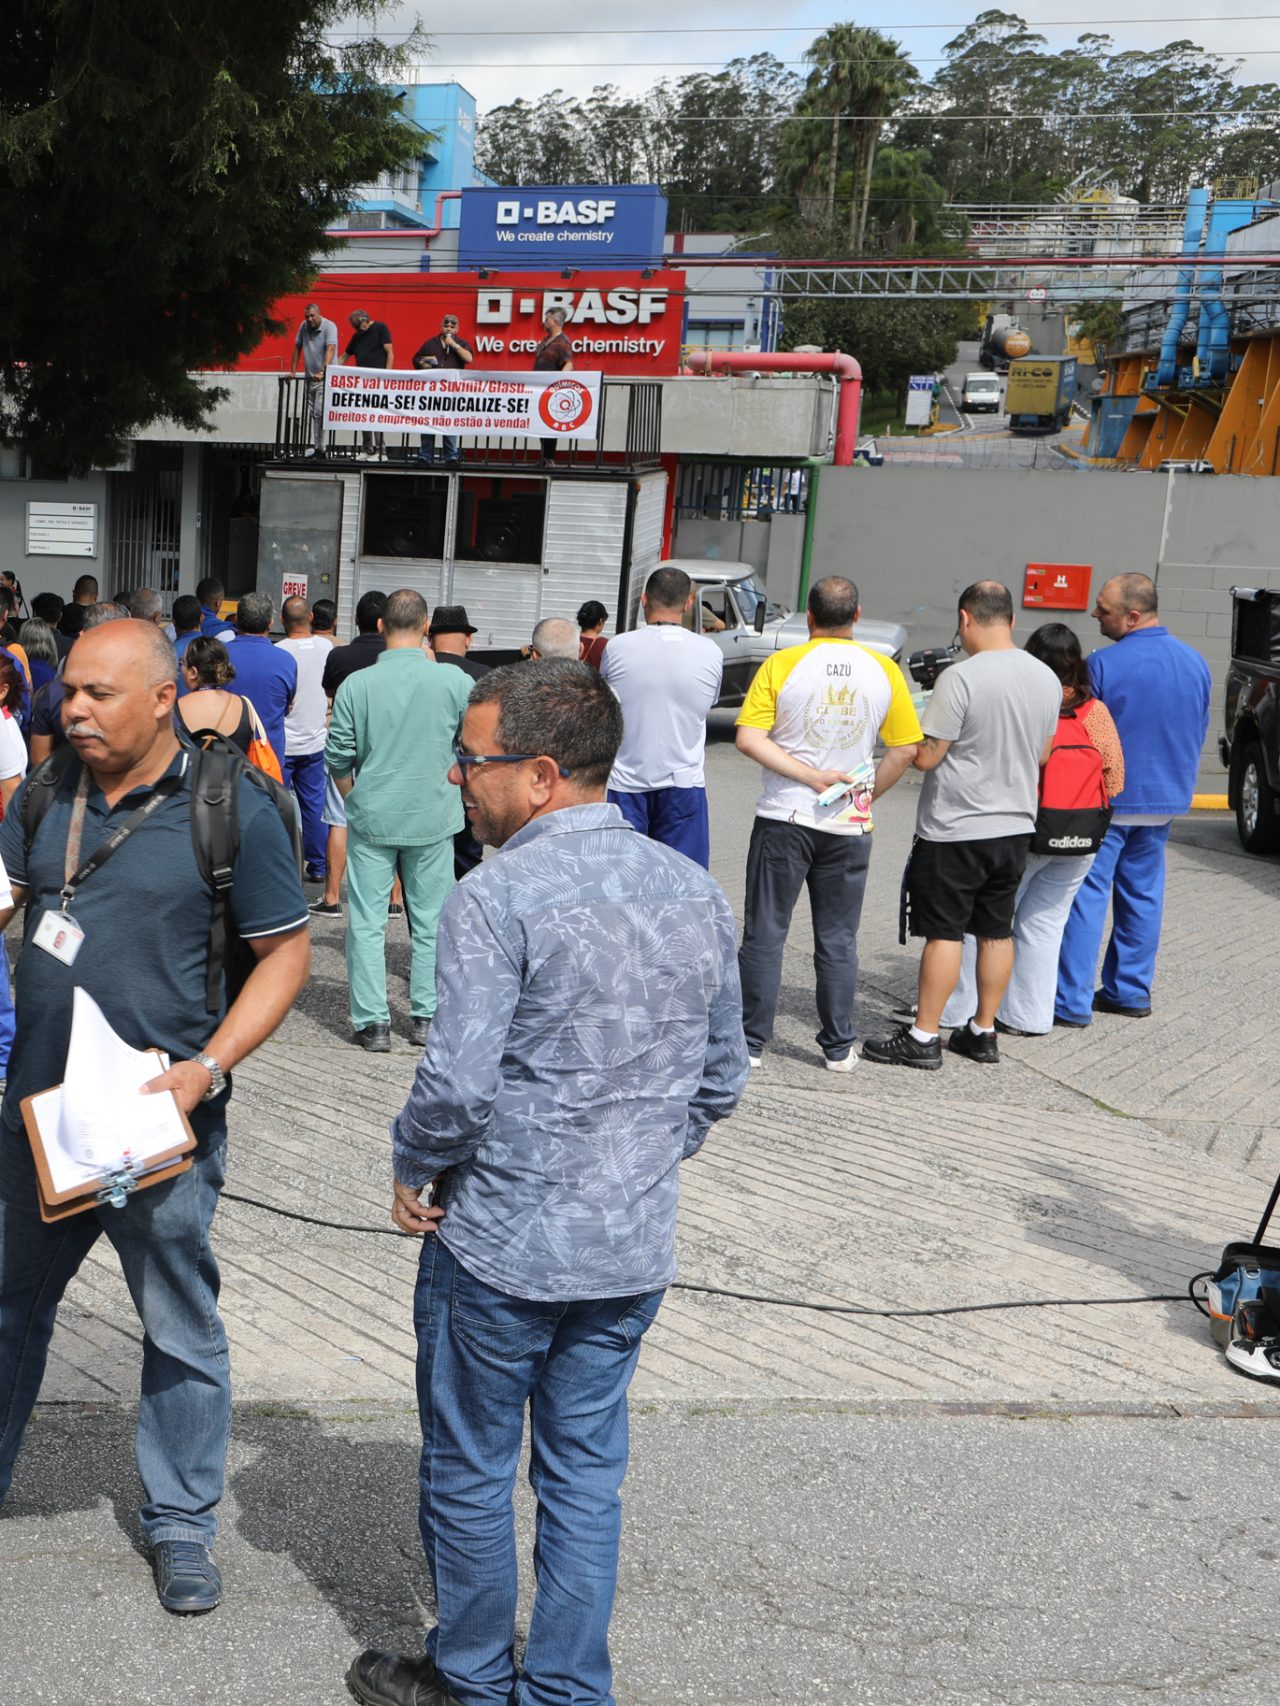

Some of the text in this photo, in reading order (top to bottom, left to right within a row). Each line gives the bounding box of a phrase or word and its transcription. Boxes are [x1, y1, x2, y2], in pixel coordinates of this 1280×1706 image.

[537, 200, 616, 224] BASF
[496, 230, 614, 243] We create chemistry
[542, 287, 669, 324] BASF
[475, 336, 665, 356] We cre chemistry
[330, 375, 360, 388] BASF
[363, 377, 380, 389] vai
[383, 378, 427, 391] vender
[429, 381, 436, 392] a
[332, 392, 529, 413] DEFENDA-SE! SINDICALIZE-SE!
[328, 411, 530, 429] Direitos e empregos não estão à venda!
[552, 422, 576, 431] ABC
[283, 581, 306, 596] GREVE
[816, 706, 857, 716] CLBE
[1048, 836, 1092, 848] adidas
